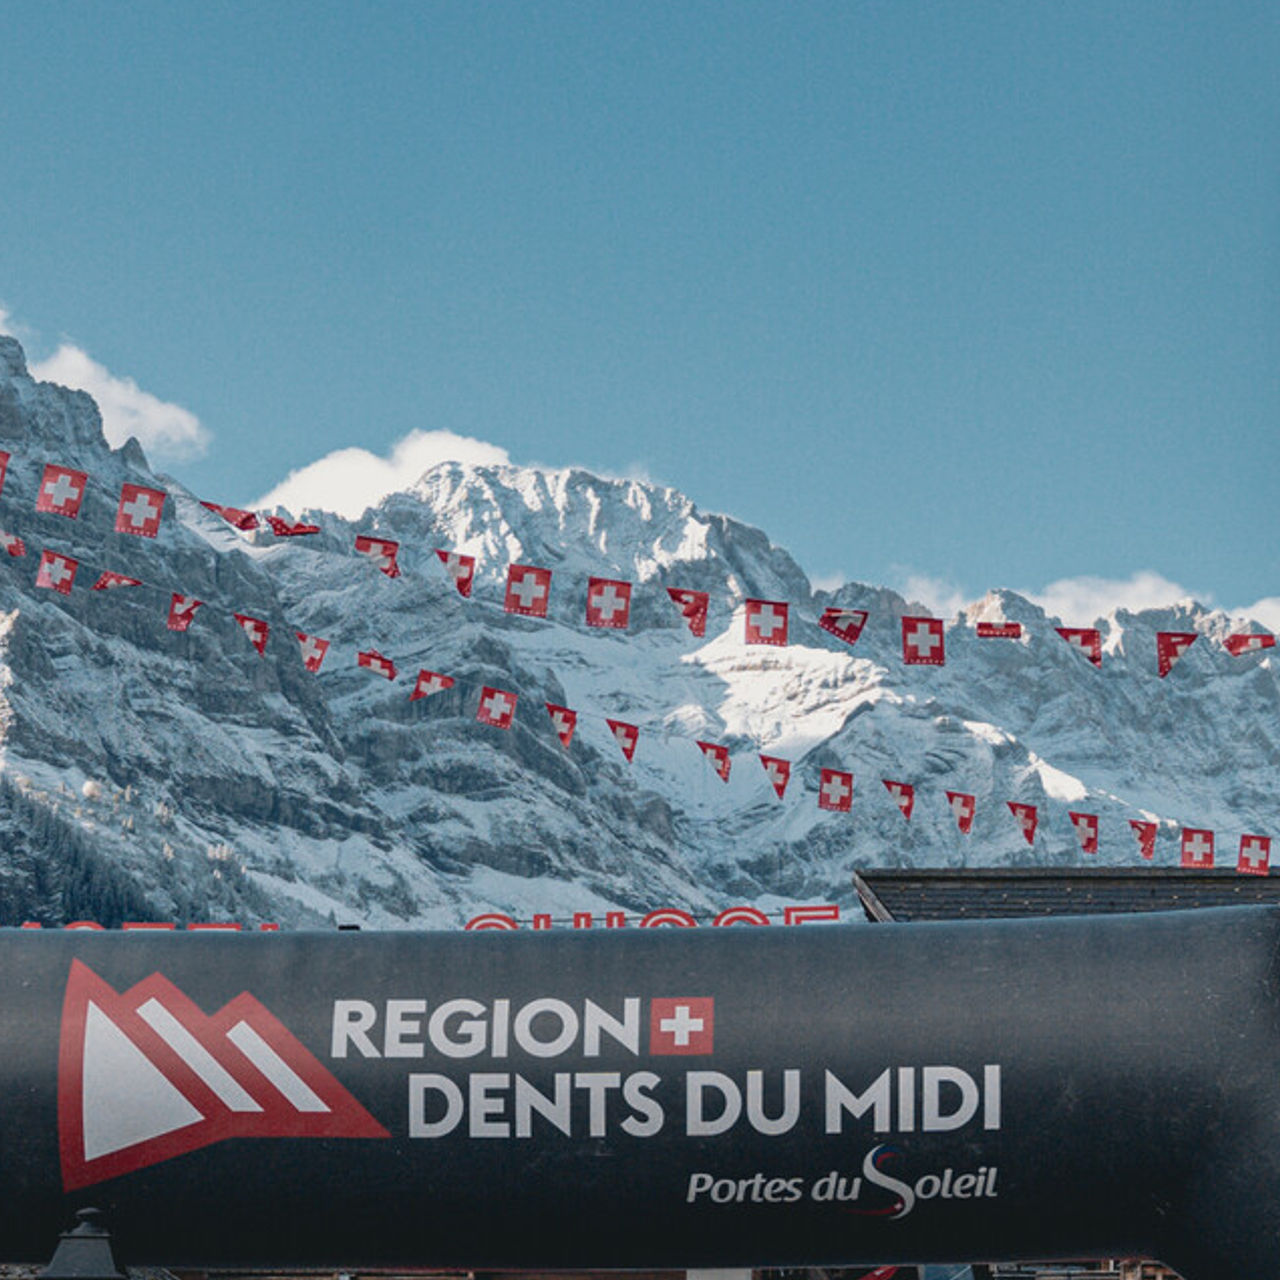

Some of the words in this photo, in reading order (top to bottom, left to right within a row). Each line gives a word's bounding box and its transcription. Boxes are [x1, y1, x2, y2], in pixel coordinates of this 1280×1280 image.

[331, 997, 641, 1058] REGION
[408, 1072, 664, 1138] DENTS
[685, 1069, 800, 1136] DU
[825, 1065, 1001, 1135] MIDI
[686, 1171, 804, 1203] Portes
[811, 1171, 861, 1201] du
[862, 1144, 998, 1220] Soleil
